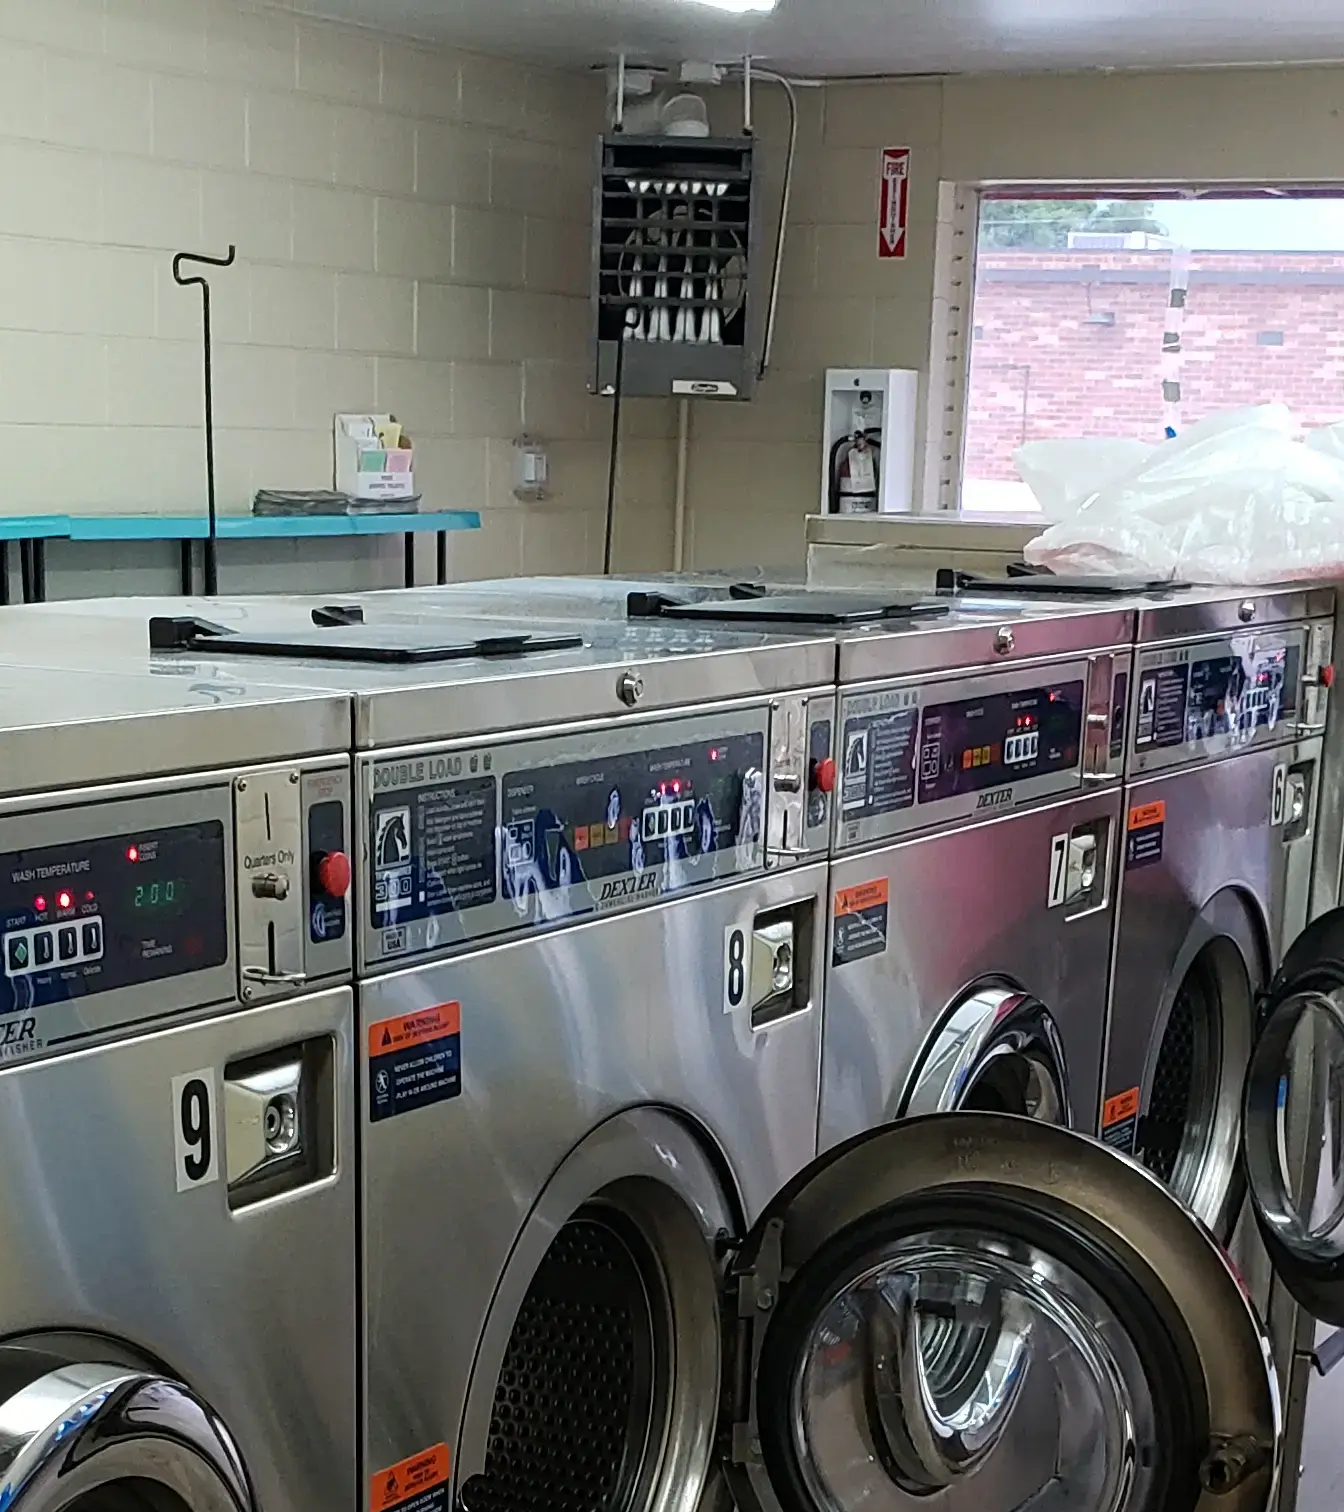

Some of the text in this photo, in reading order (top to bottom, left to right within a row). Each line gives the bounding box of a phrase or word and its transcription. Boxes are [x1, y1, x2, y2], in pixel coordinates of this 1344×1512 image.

[976, 788, 1012, 809] DEXTER
[1275, 769, 1282, 820] 6
[12, 859, 91, 882] WASH TEMPERATURE
[244, 848, 294, 869] Quarters Only
[1053, 840, 1065, 900] 7
[599, 871, 658, 900] DEXTER
[6, 916, 26, 928] START
[35, 912, 48, 922] HOT
[728, 929, 744, 1006] 8
[181, 1079, 211, 1180] 9
